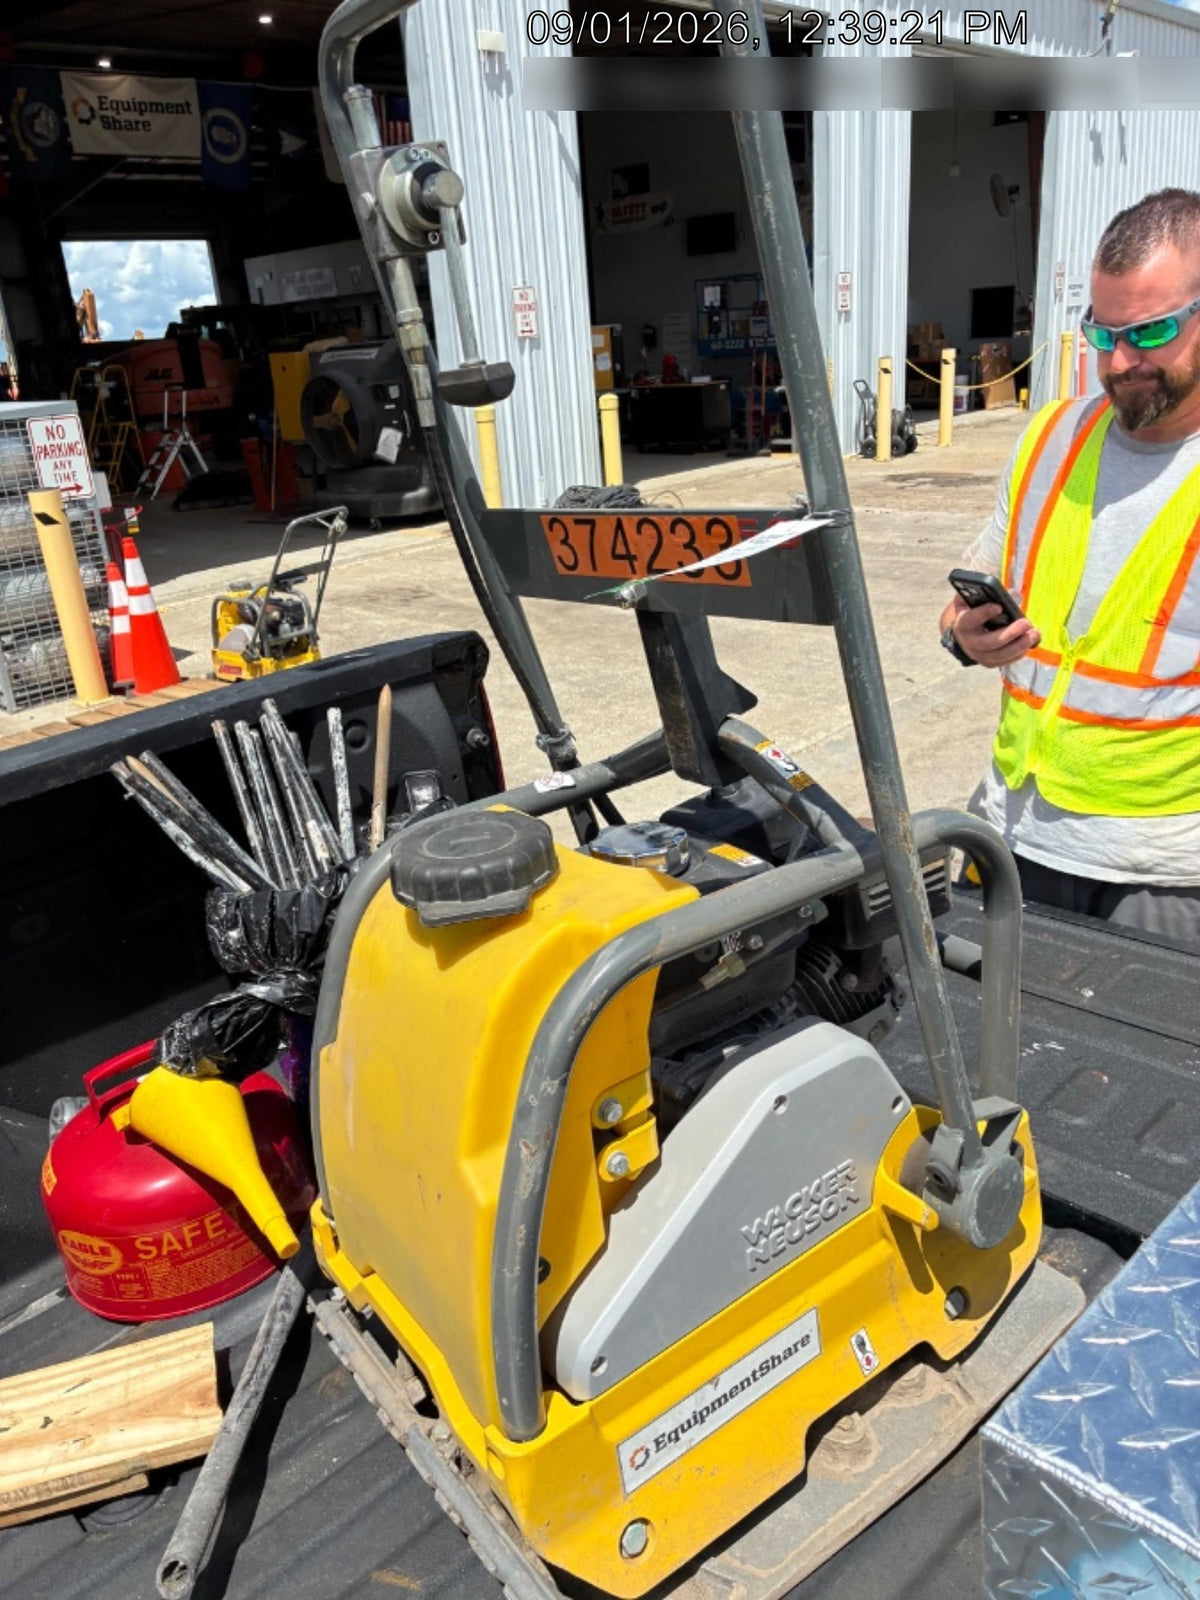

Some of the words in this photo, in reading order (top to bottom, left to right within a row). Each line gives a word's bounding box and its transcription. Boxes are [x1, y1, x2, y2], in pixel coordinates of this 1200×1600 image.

[97, 95, 193, 115] Equipment
[100, 115, 152, 132] Share
[45, 424, 66, 441] NO
[35, 441, 82, 461] PARKING
[52, 460, 72, 470] ANY
[53, 470, 78, 483] TIME
[549, 517, 742, 581] 374233
[740, 1158, 858, 1247] WACKER
[746, 1187, 860, 1273] NEUSON
[653, 1332, 811, 1453] EquipmentShare
